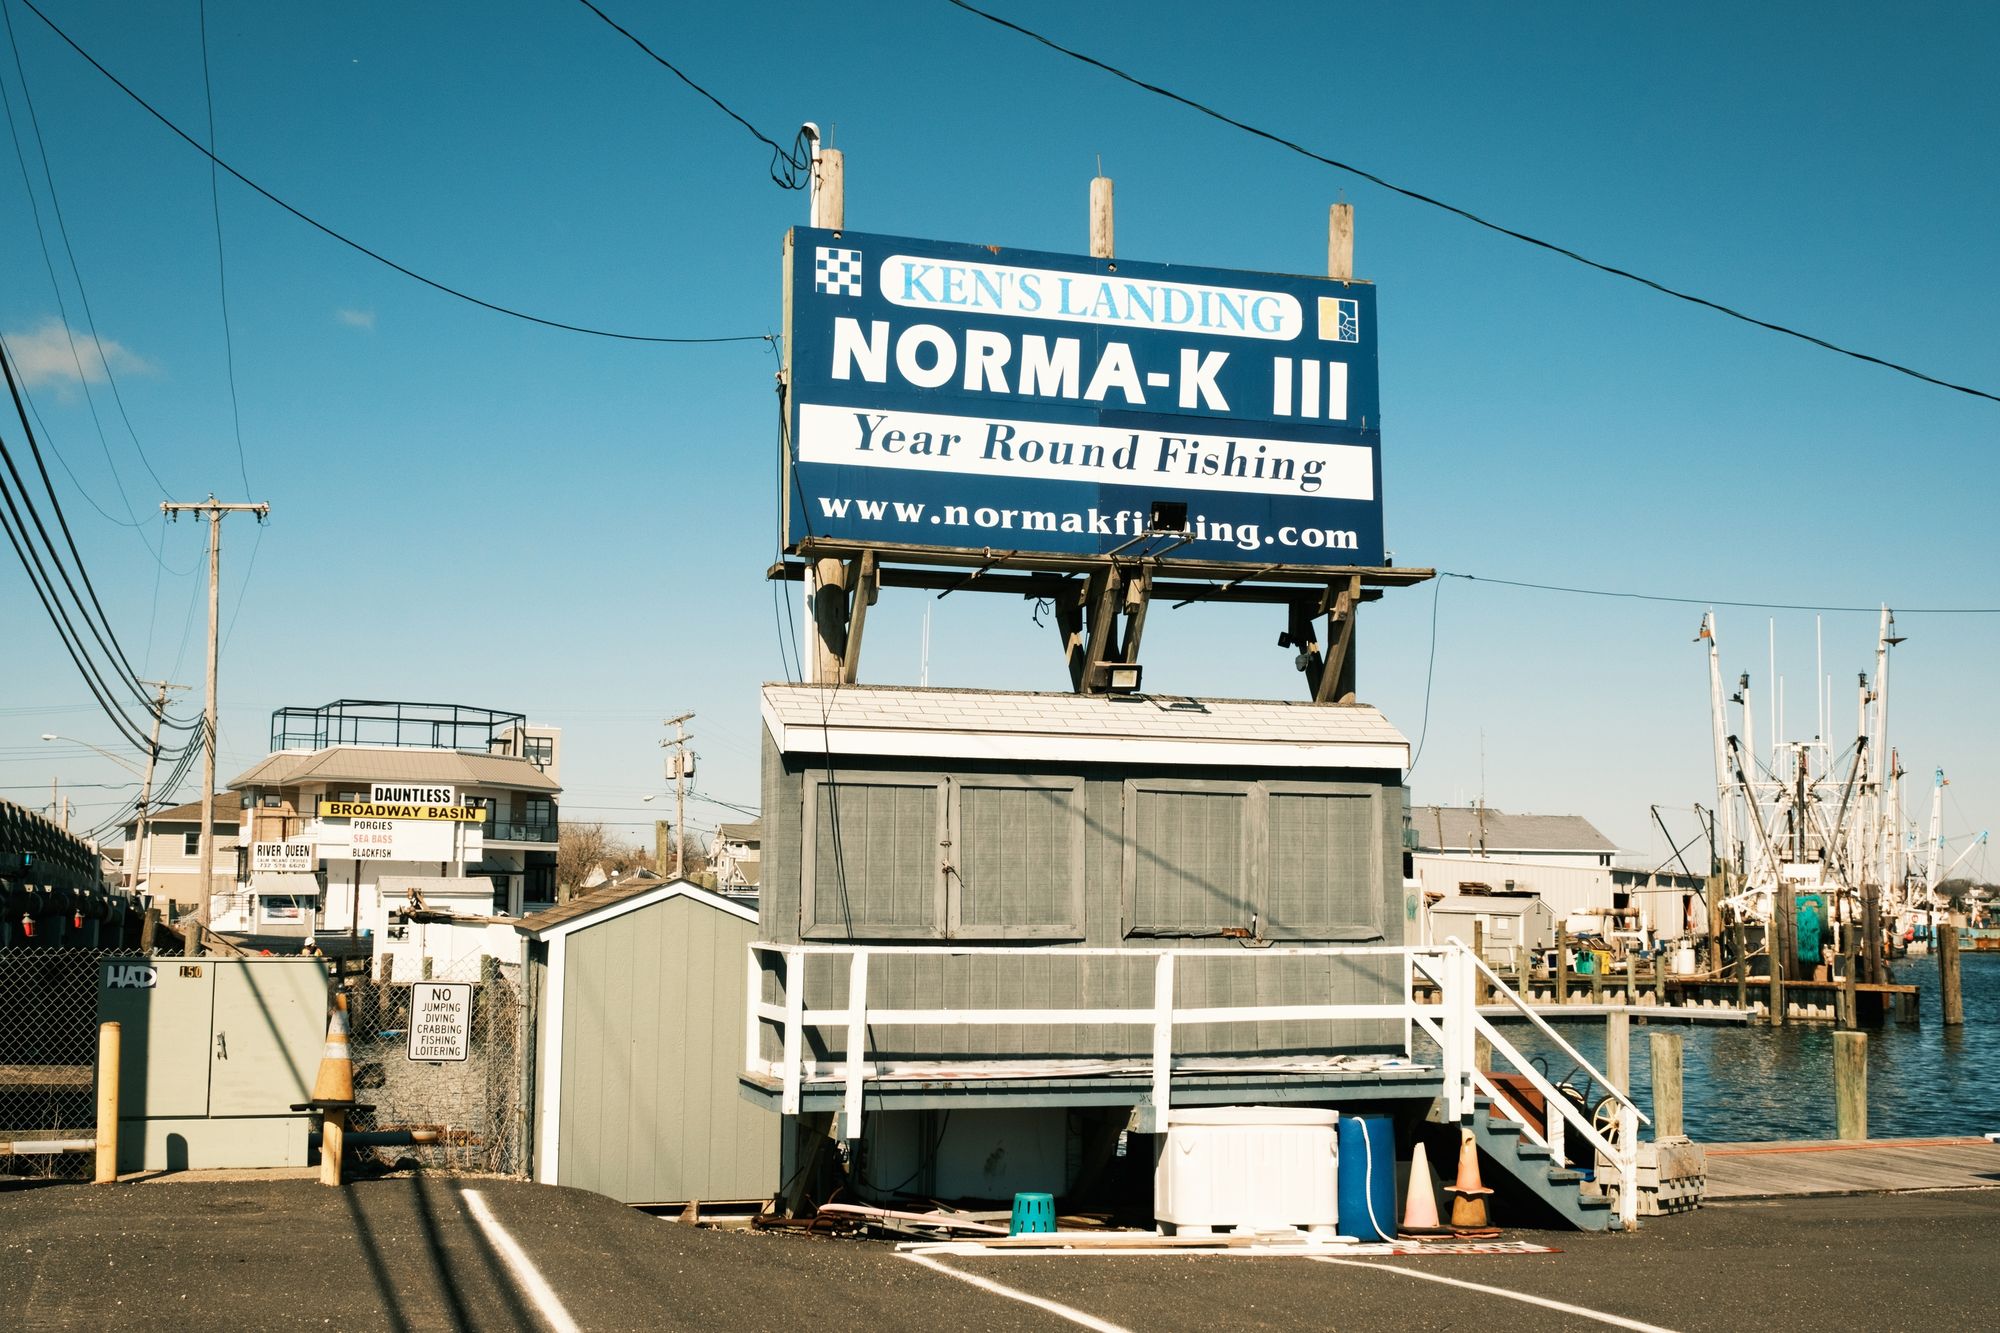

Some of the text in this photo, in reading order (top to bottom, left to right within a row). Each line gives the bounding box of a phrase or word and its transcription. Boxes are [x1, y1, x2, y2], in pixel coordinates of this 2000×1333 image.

[898, 262, 1284, 332] KEN'S LANDING
[831, 317, 1348, 420] NORMA-K III
[853, 412, 1326, 492] Year Round Fishing
[818, 496, 1358, 550] www.normakfiing.com
[375, 788, 451, 803] DAUNTLESS
[330, 804, 476, 819] BROADWAY BASIN
[354, 821, 393, 830] PORGIES
[353, 834, 393, 844] SEA BASS
[257, 844, 310, 858] RIVER QUEEN
[352, 848, 392, 858] BLACKFISH
[180, 965, 202, 978] 150
[432, 988, 451, 1001] NO
[421, 1003, 461, 1012] JUMPING
[425, 1013, 455, 1023] DIVING
[417, 1024, 462, 1034] CRABBING
[421, 1035, 456, 1045] FISHING
[415, 1046, 461, 1056] LOITERING
